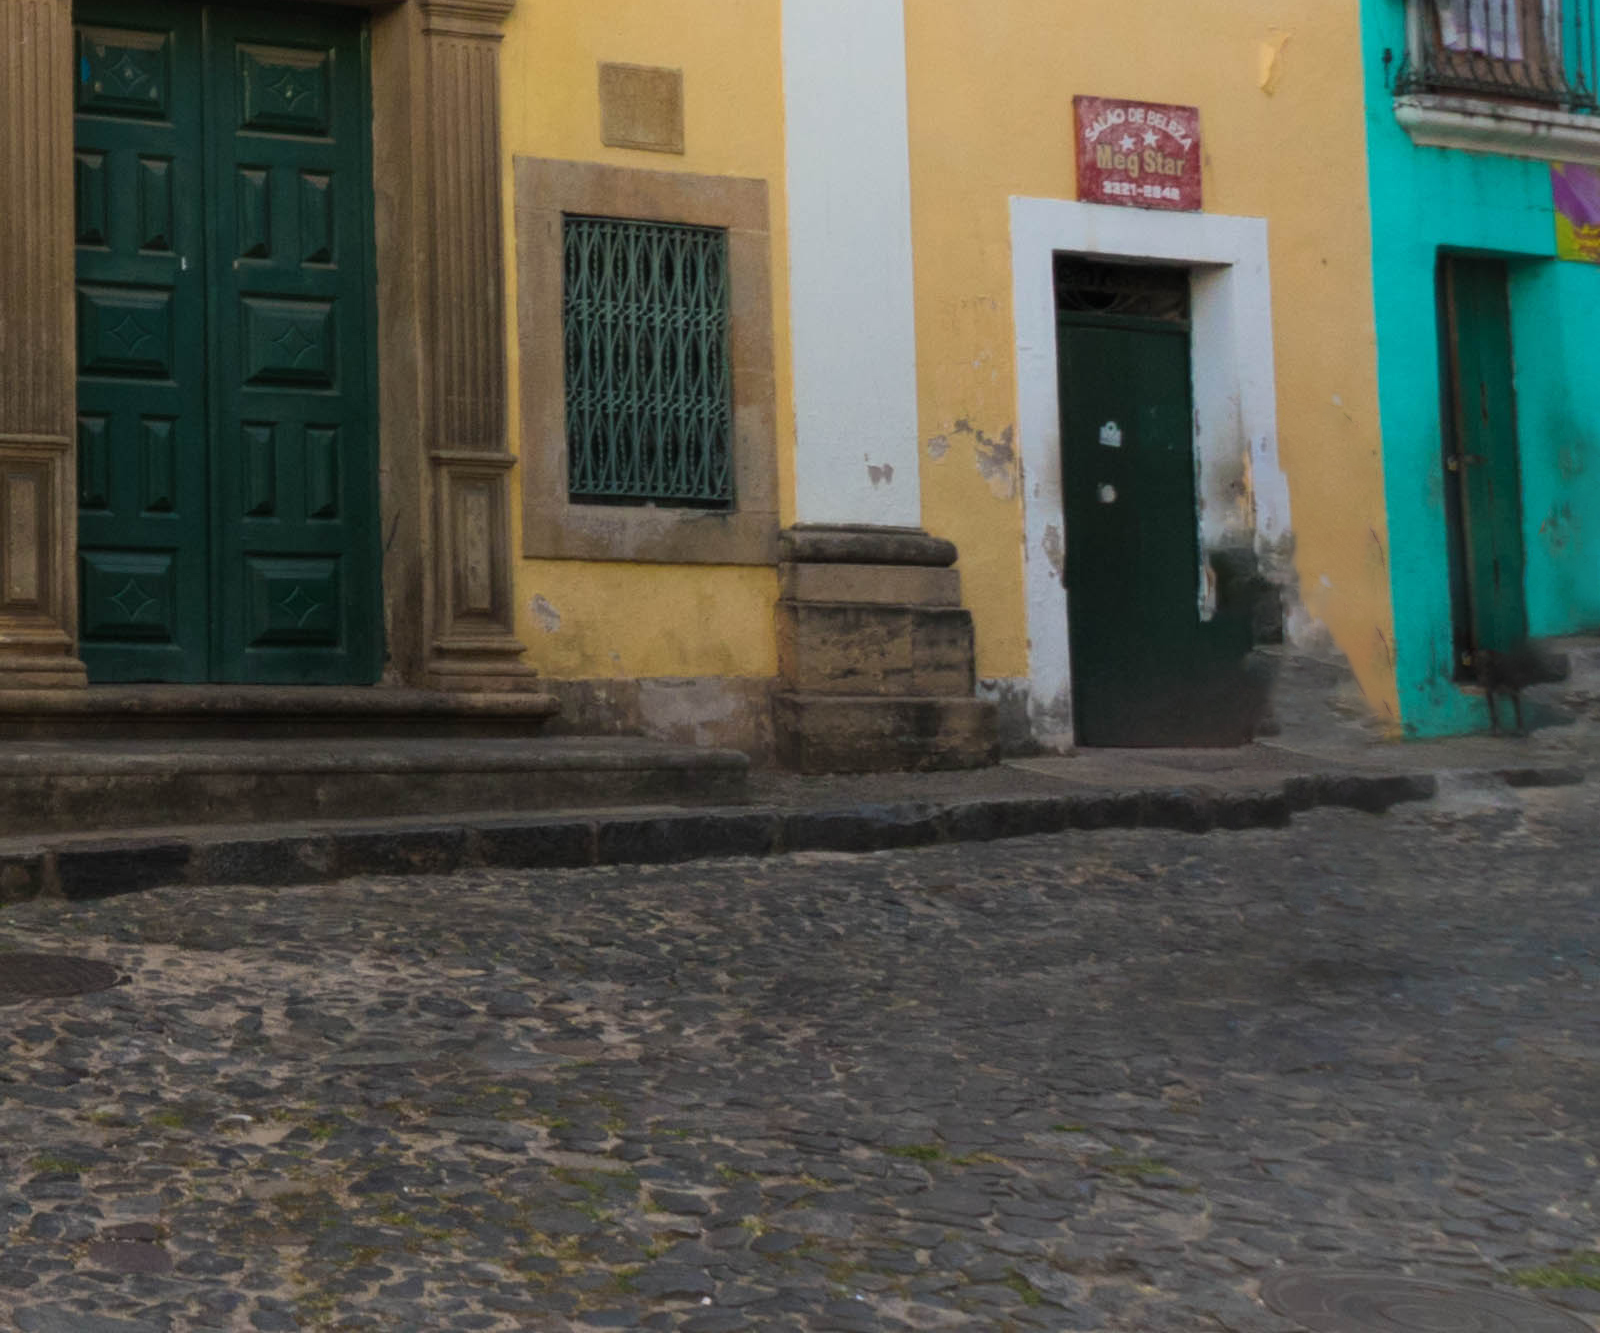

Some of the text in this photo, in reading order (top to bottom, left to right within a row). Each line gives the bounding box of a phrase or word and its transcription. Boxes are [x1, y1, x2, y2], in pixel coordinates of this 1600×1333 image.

[1128, 108, 1145, 123] DE
[1147, 109, 1193, 150] BELEZA
[1096, 143, 1186, 179] Meg Star
